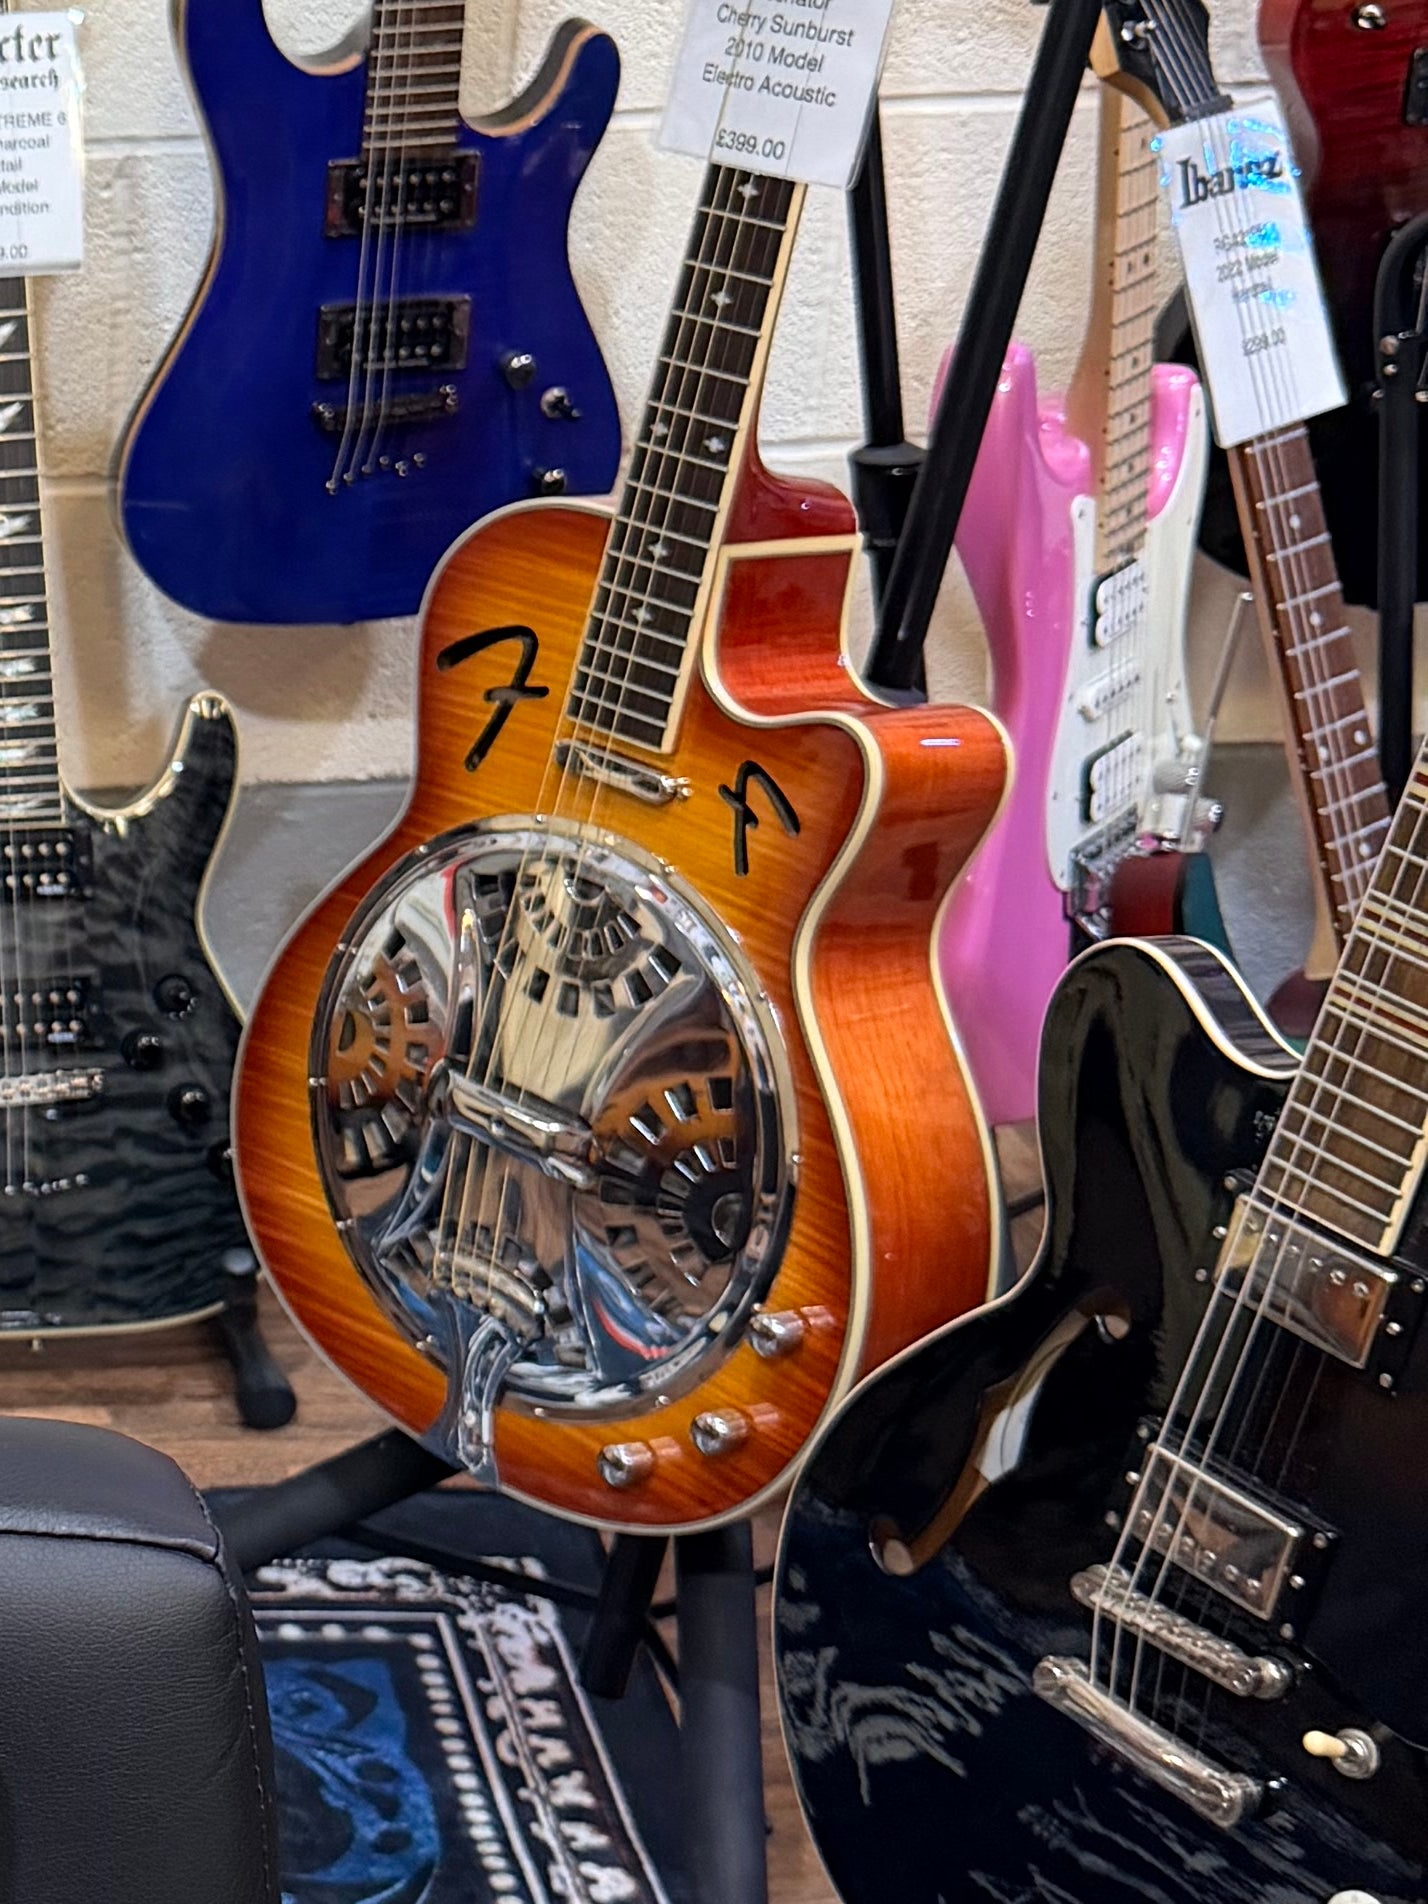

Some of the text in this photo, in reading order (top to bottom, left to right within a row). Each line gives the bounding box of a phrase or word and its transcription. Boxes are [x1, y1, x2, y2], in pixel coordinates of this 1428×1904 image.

[716, 3, 854, 48] Cherry Sunburst
[724, 36, 825, 74] 2010 Model
[702, 62, 837, 109] Electro Acoustic
[715, 128, 786, 161] £399.00
